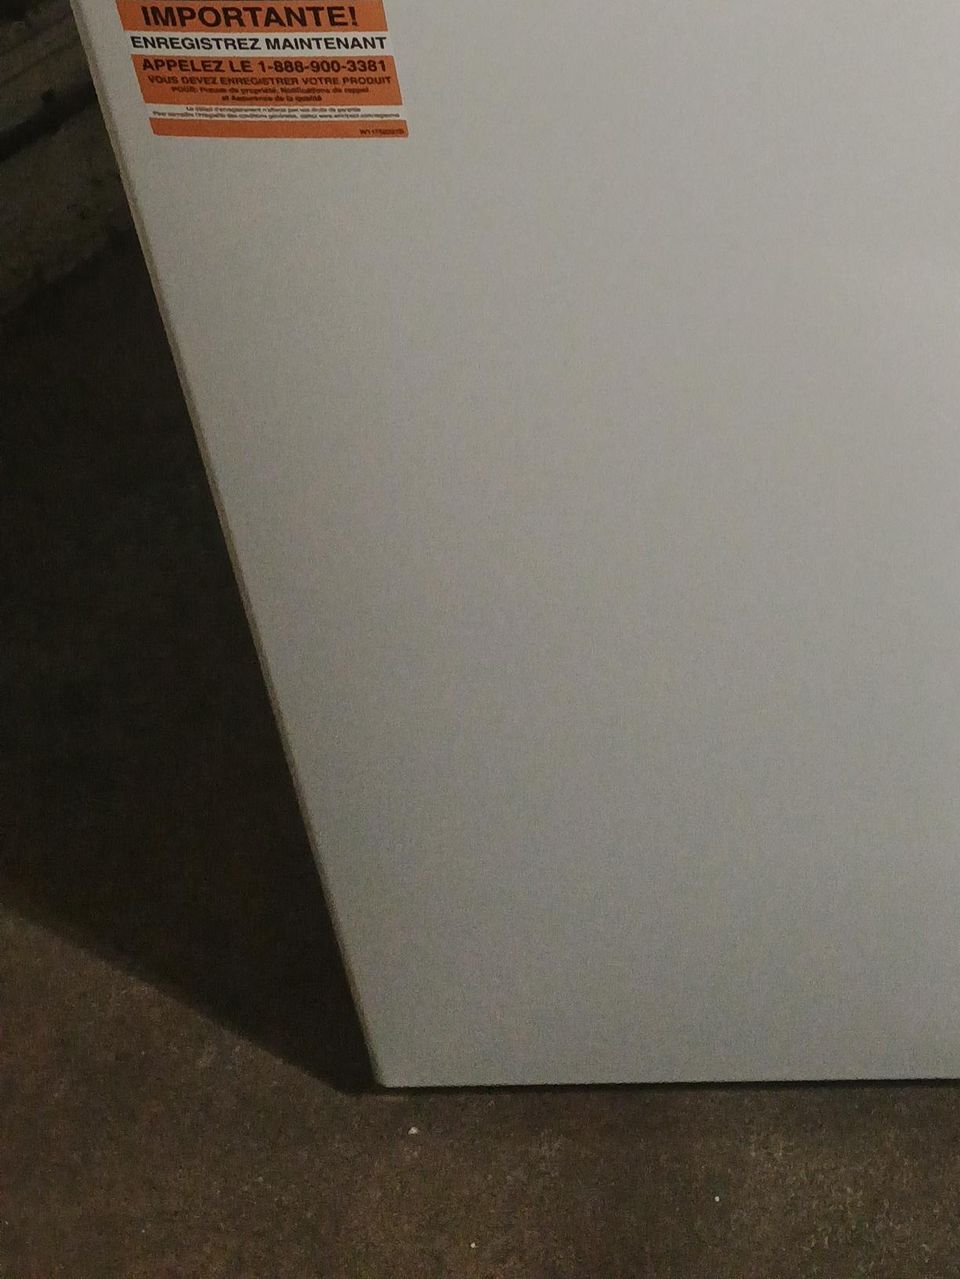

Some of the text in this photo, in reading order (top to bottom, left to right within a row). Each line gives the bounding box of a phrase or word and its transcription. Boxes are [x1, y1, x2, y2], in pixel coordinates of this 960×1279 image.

[140, 5, 359, 28] IMPORTANTE!
[131, 36, 387, 51] ENREGISTREZ MAINTENANT
[143, 58, 386, 73] APPELEZ LE 1-888-900-3381
[148, 75, 391, 85] VOUS DEVEZ ENREGISTRER VOTRE PRODUIT
